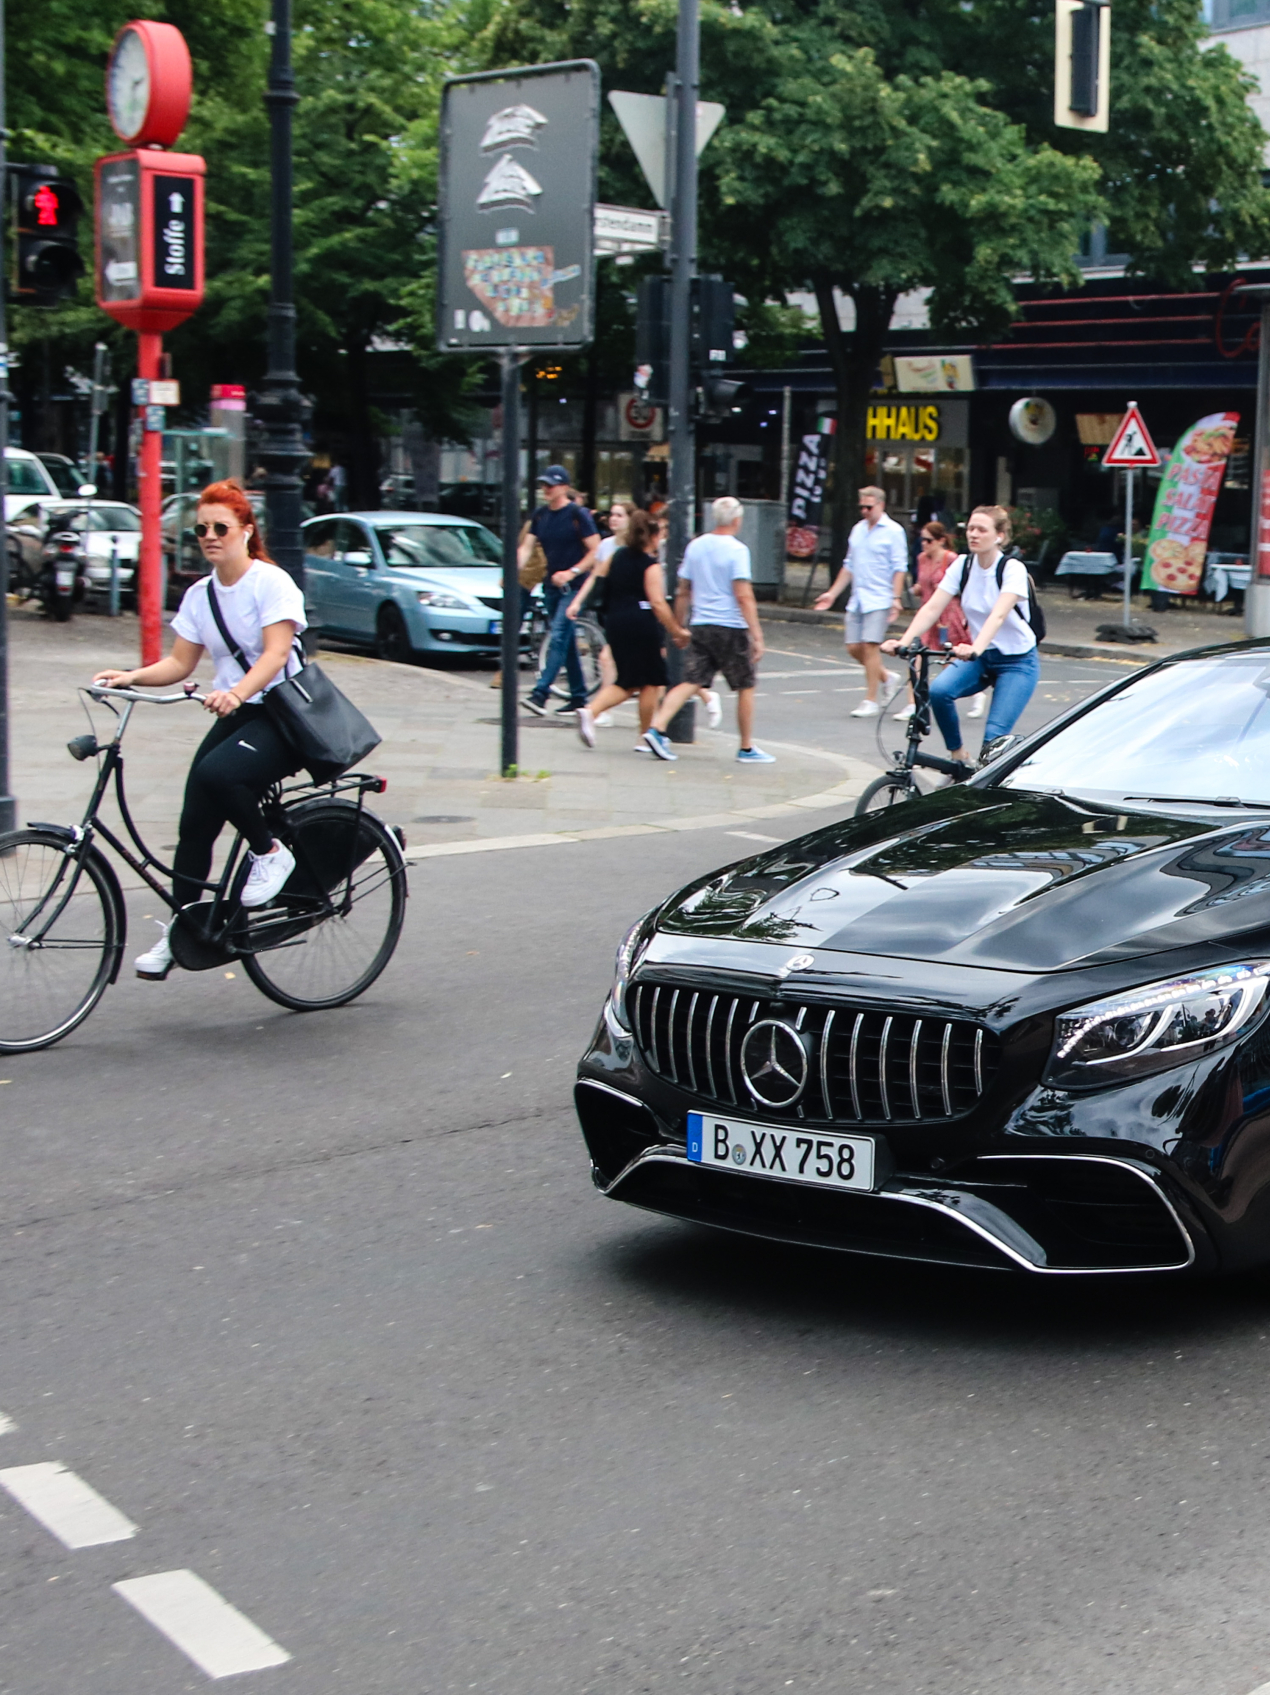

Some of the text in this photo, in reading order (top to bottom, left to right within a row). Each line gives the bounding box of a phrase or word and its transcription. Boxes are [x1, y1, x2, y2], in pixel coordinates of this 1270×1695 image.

[163, 219, 186, 276] Stoffe
[866, 405, 939, 441] HHAUS
[791, 433, 822, 520] PIZZA
[1166, 463, 1221, 491] PASTA
[1155, 511, 1210, 538] PIZZA
[692, 1123, 856, 1180] D B XX 758
